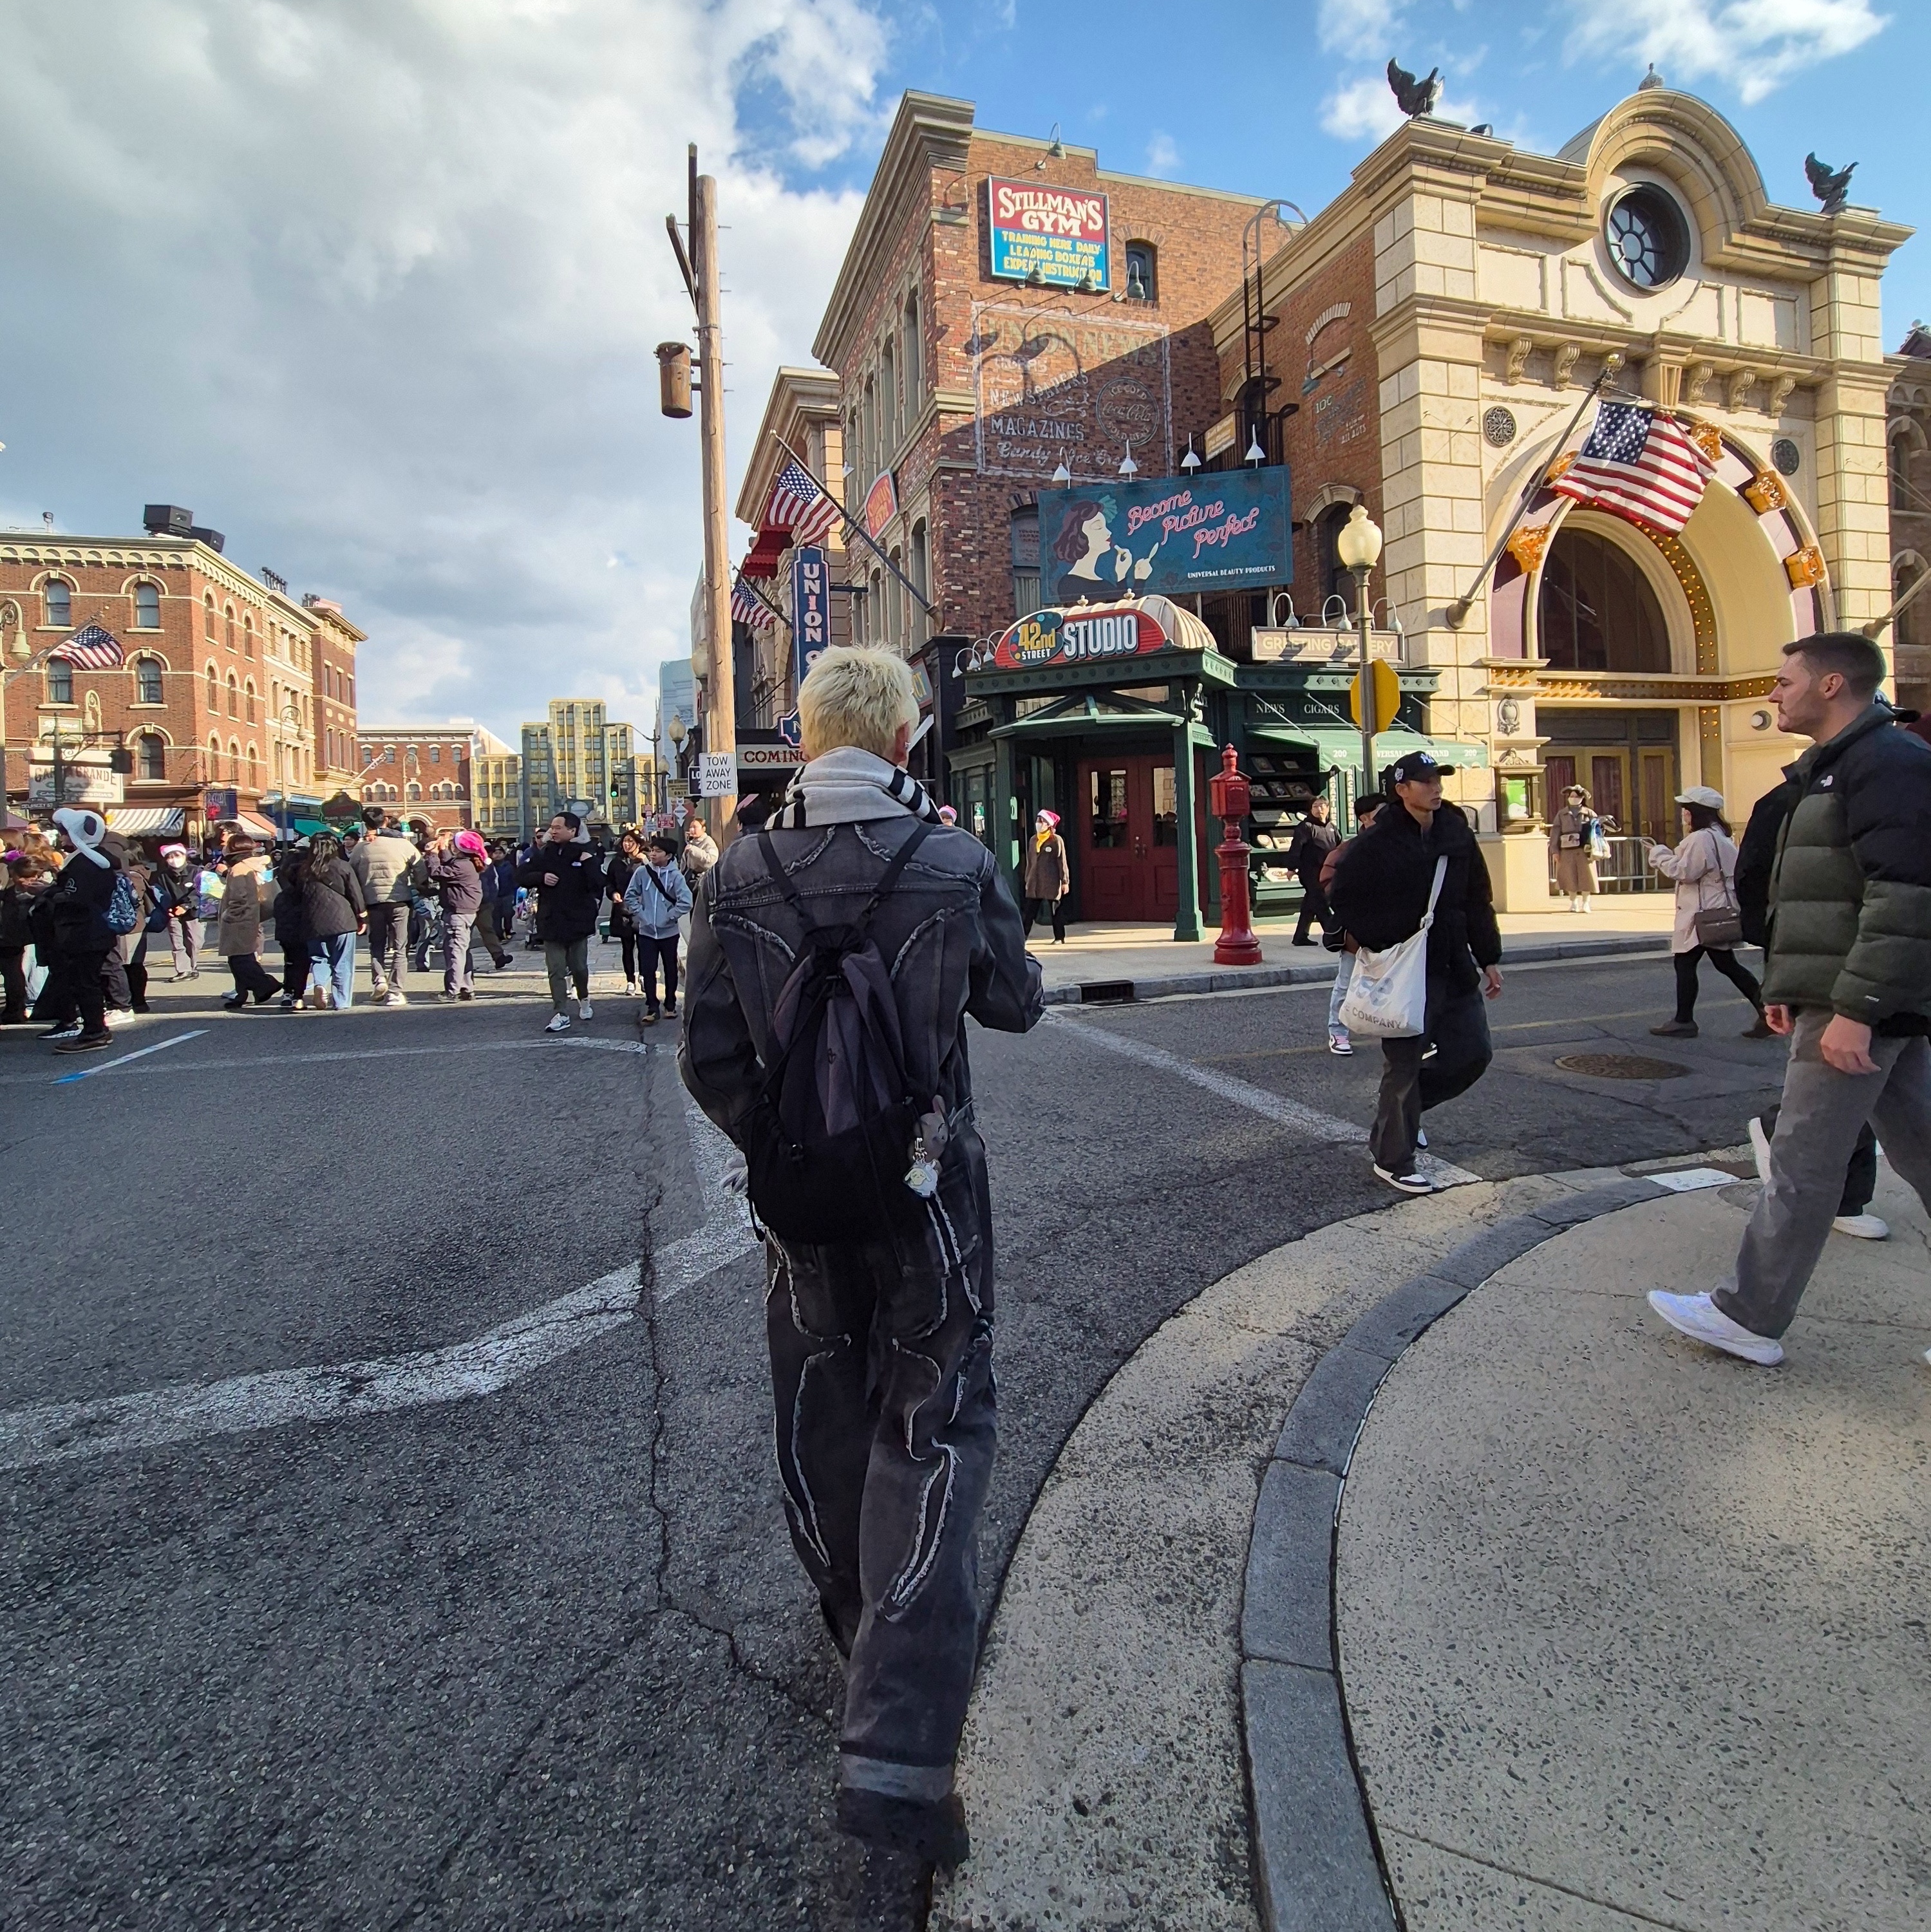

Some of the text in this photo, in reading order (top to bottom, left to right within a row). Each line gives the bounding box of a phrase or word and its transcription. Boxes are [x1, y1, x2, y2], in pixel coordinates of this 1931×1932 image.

[998, 187, 1103, 230] STILLMAN'S
[1021, 210, 1082, 236] GYM
[1002, 230, 1047, 247] TRAINING
[1050, 238, 1073, 250] HERE
[1010, 245, 1095, 267] LEADING BOXERS
[1082, 330, 1160, 366] NEWS
[990, 370, 1089, 407] NEWSPAPERS
[1124, 385, 1147, 400] COLD
[992, 415, 1084, 441] MAGAZINES
[1107, 421, 1127, 439] SOLD
[1128, 490, 1192, 536] Become
[1161, 500, 1225, 545] Picture
[1192, 507, 1259, 559] Perfect
[1188, 565, 1275, 579] UNIVERSAL BEAUTY PRODUCTS
[803, 563, 822, 642] UNION
[1018, 622, 1055, 651] 42nd
[1064, 614, 1137, 657] STUDIO
[1263, 636, 1394, 653] GREETING GALERY
[1022, 648, 1051, 660] STREET
[1256, 703, 1339, 714] NEWS CIGARS
[707, 756, 728, 766] TOW
[1333, 749, 1347, 758] 200
[1464, 749, 1478, 757] 200
[706, 767, 731, 778] AWAY
[706, 780, 731, 791] ZONE
[1352, 1007, 1401, 1029] COMPANY
